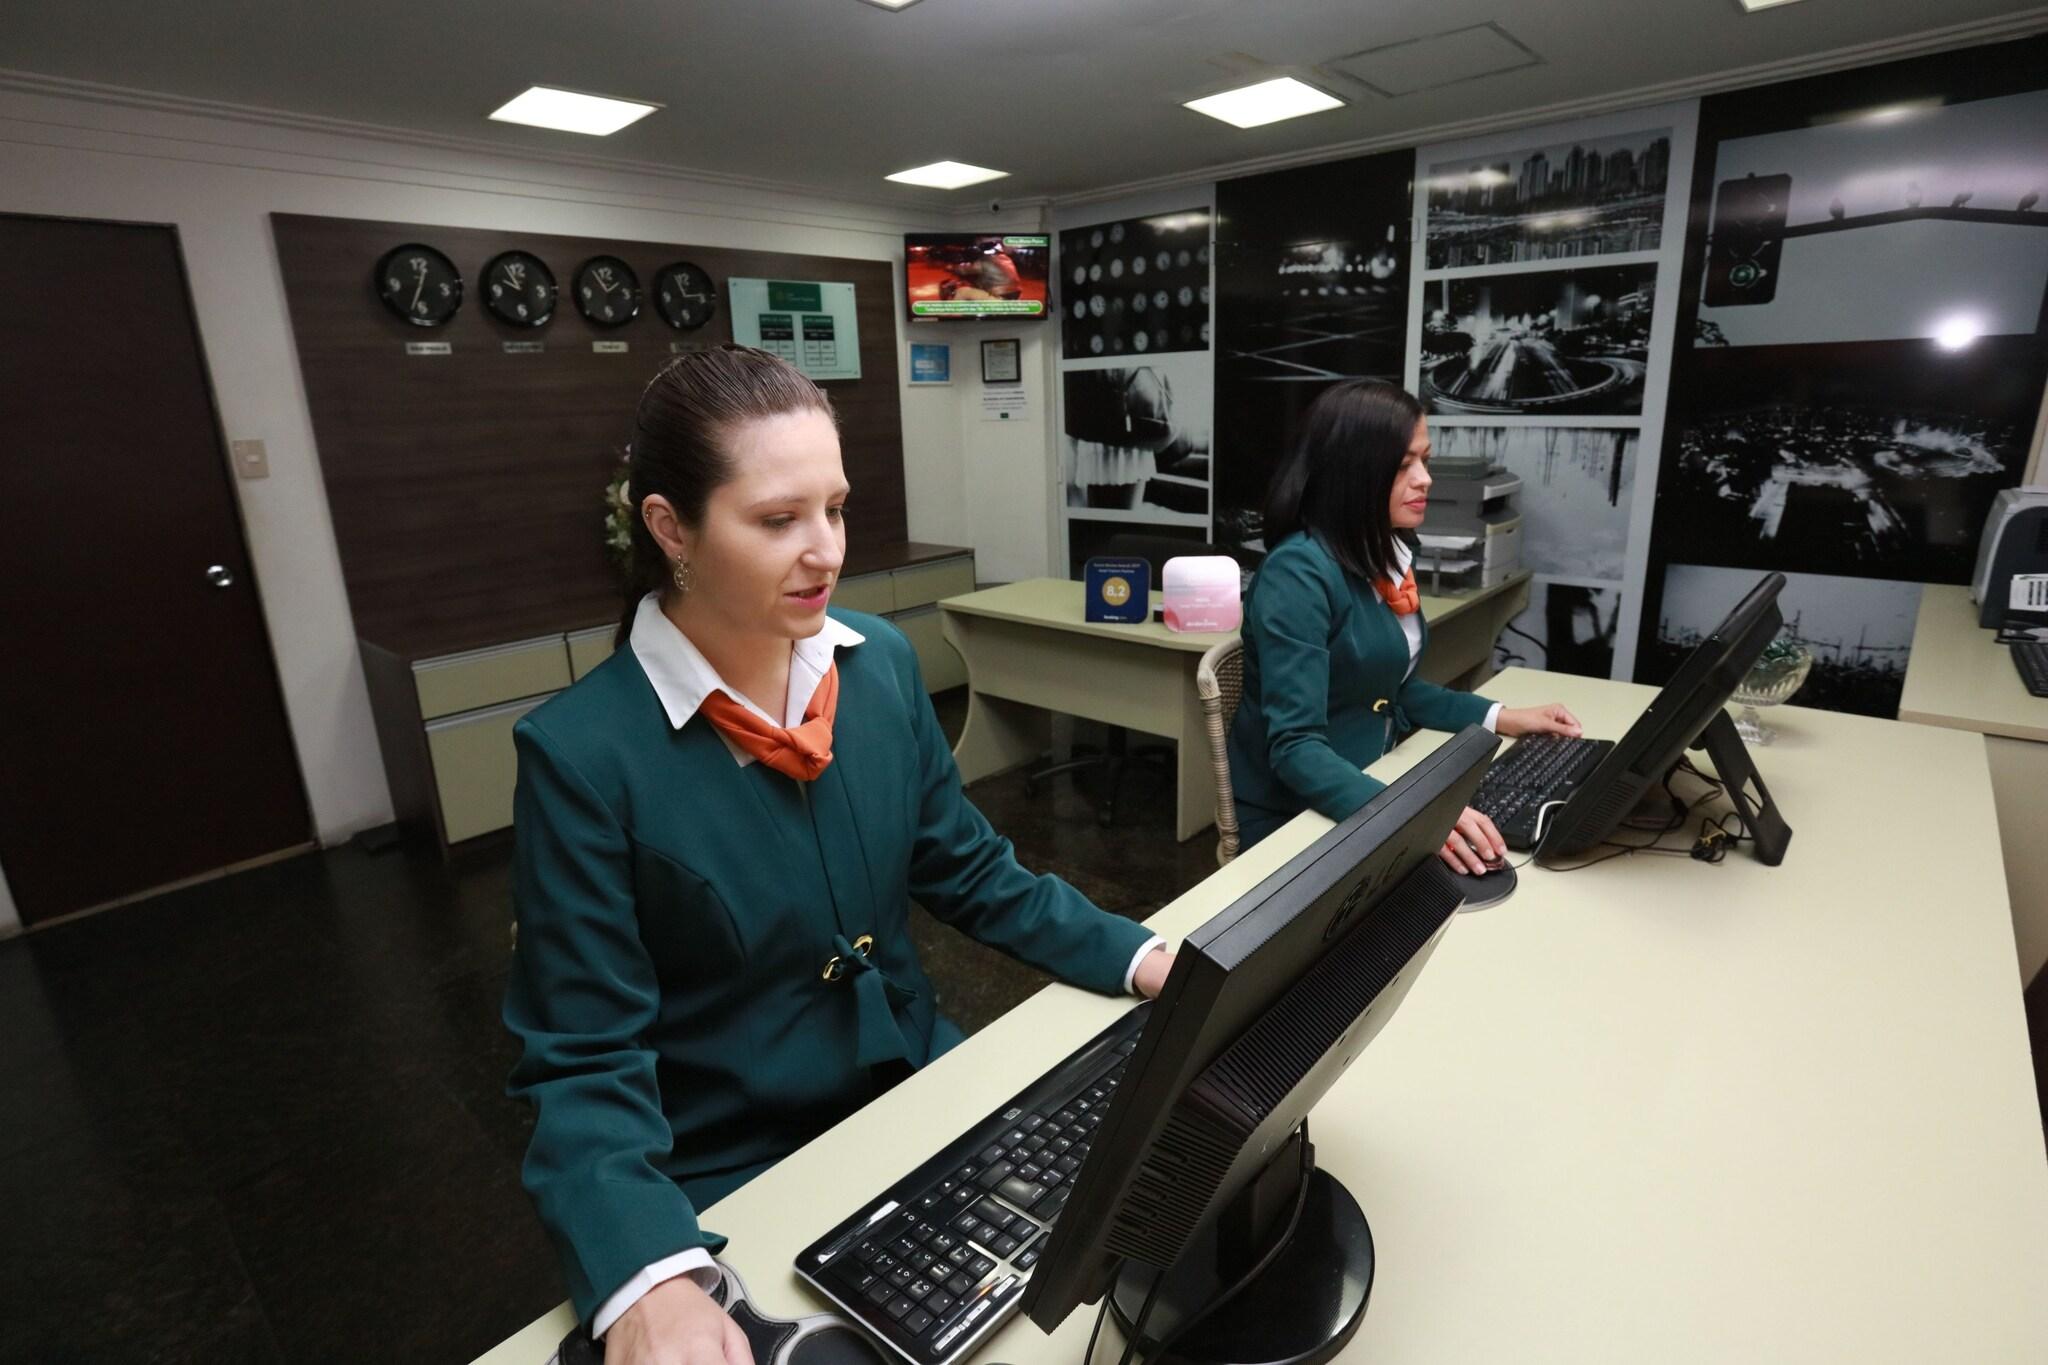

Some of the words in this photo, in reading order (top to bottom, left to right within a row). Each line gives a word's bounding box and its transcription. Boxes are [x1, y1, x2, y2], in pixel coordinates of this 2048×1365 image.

[410, 258, 428, 274] 12
[509, 262, 526, 278] 12
[598, 266, 613, 280] 12
[390, 278, 401, 292] 9
[440, 282, 450, 297] 3
[492, 284, 502, 298] 9
[536, 284, 546, 299] 3
[622, 288, 631, 300] 3
[417, 300, 428, 315] 6
[517, 304, 528, 318] 6
[604, 305, 614, 318] 6
[1106, 585, 1126, 598] 8.2
